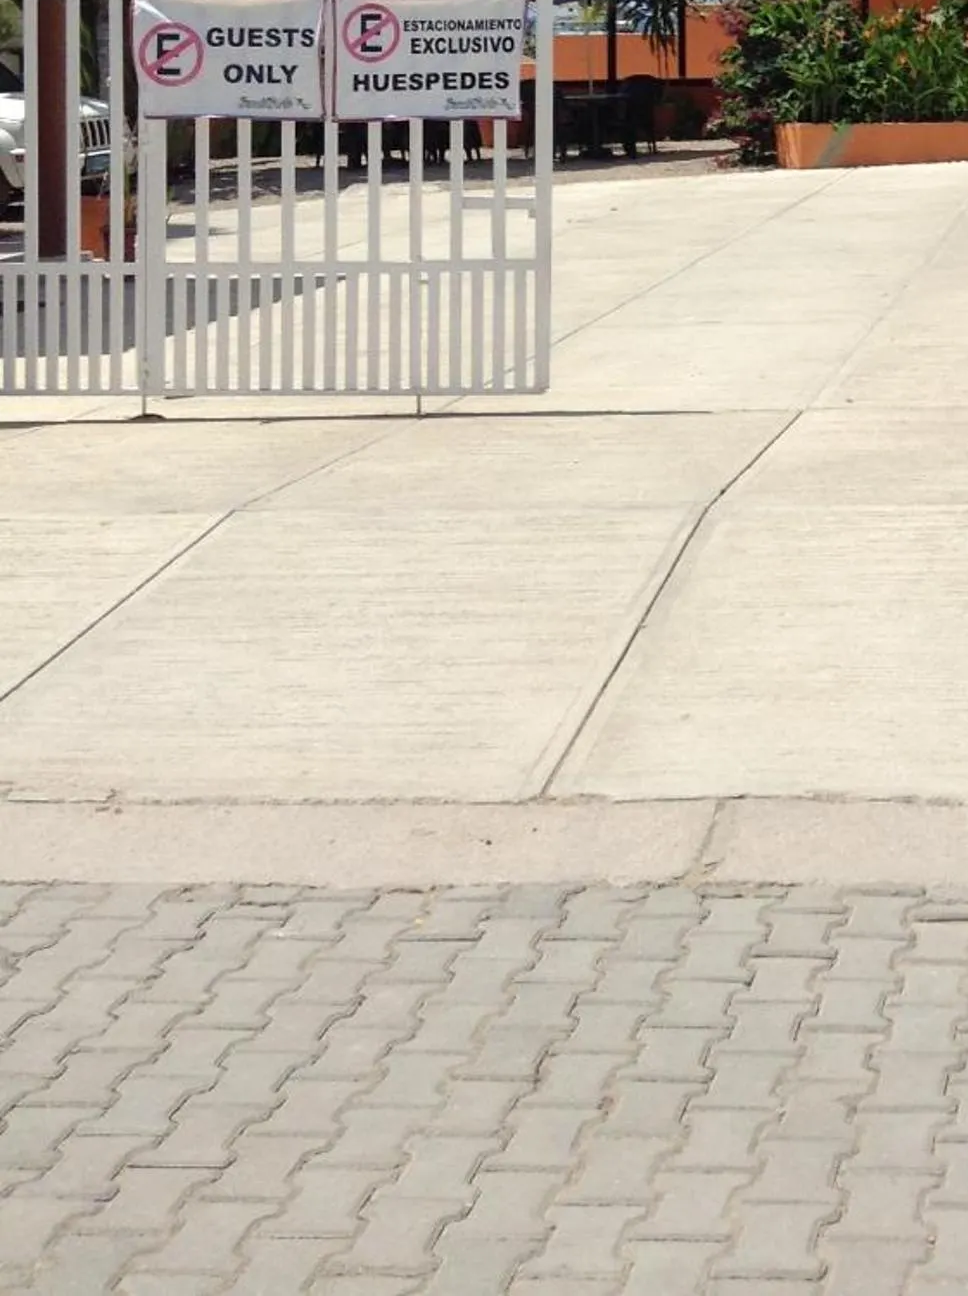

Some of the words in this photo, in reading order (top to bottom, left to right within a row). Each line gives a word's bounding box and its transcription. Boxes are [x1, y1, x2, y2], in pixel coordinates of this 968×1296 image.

[403, 18, 521, 32] ESTACIONAMIENTO
[206, 27, 315, 48] GUESTS
[410, 36, 515, 55] EXCLUSIVO
[223, 64, 298, 84] ONLY
[353, 71, 510, 92] HUESPEDES
